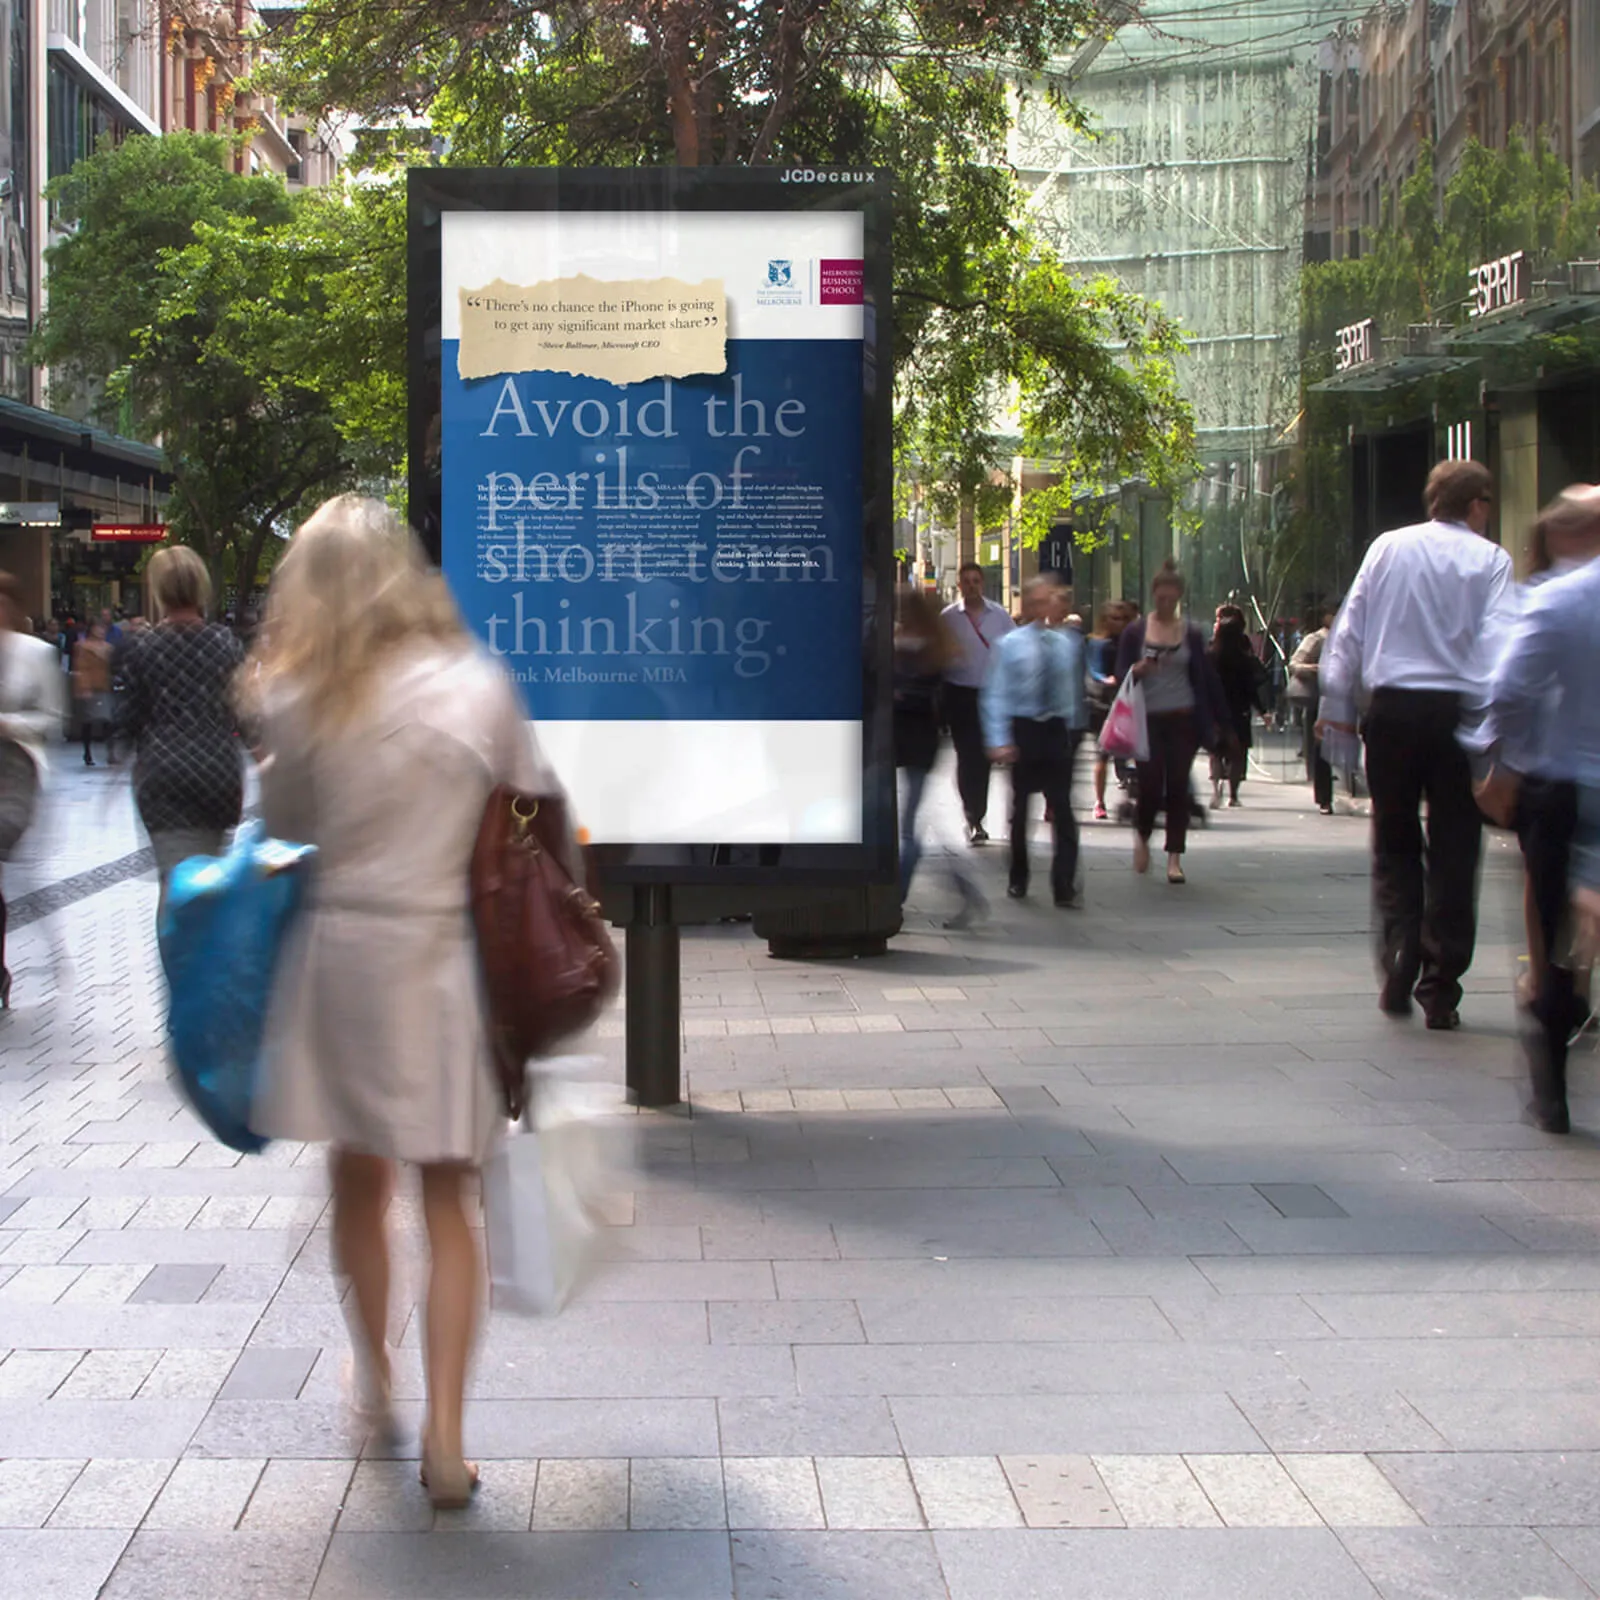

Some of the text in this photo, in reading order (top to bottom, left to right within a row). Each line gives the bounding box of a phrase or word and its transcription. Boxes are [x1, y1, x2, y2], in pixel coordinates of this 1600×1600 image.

[780, 168, 875, 183] JCDecaux
[821, 278, 862, 286] BUSINESS
[821, 286, 856, 295] SCHOOL
[1468, 250, 1523, 317] ESPRIT
[532, 303, 548, 313] no
[551, 300, 595, 313] chance
[598, 300, 618, 313] the
[621, 299, 664, 313] iPhone
[668, 299, 677, 312] is
[680, 298, 714, 314] going
[494, 320, 507, 330] to
[510, 320, 529, 333] get
[532, 323, 554, 334] any
[558, 319, 619, 335] significant
[623, 318, 666, 331] market
[601, 341, 639, 350] Microsoft
[640, 340, 660, 348] CEO
[1336, 318, 1372, 370] ESPRIT
[479, 373, 806, 438] Avoid the
[484, 446, 761, 531] perils of
[484, 519, 838, 583] short-term
[747, 551, 764, 561] perils
[1051, 541, 1073, 568] GA
[767, 560, 800, 568] Melbourne
[485, 591, 787, 678] thinking.
[503, 666, 687, 683] ink Melbourne MBA
